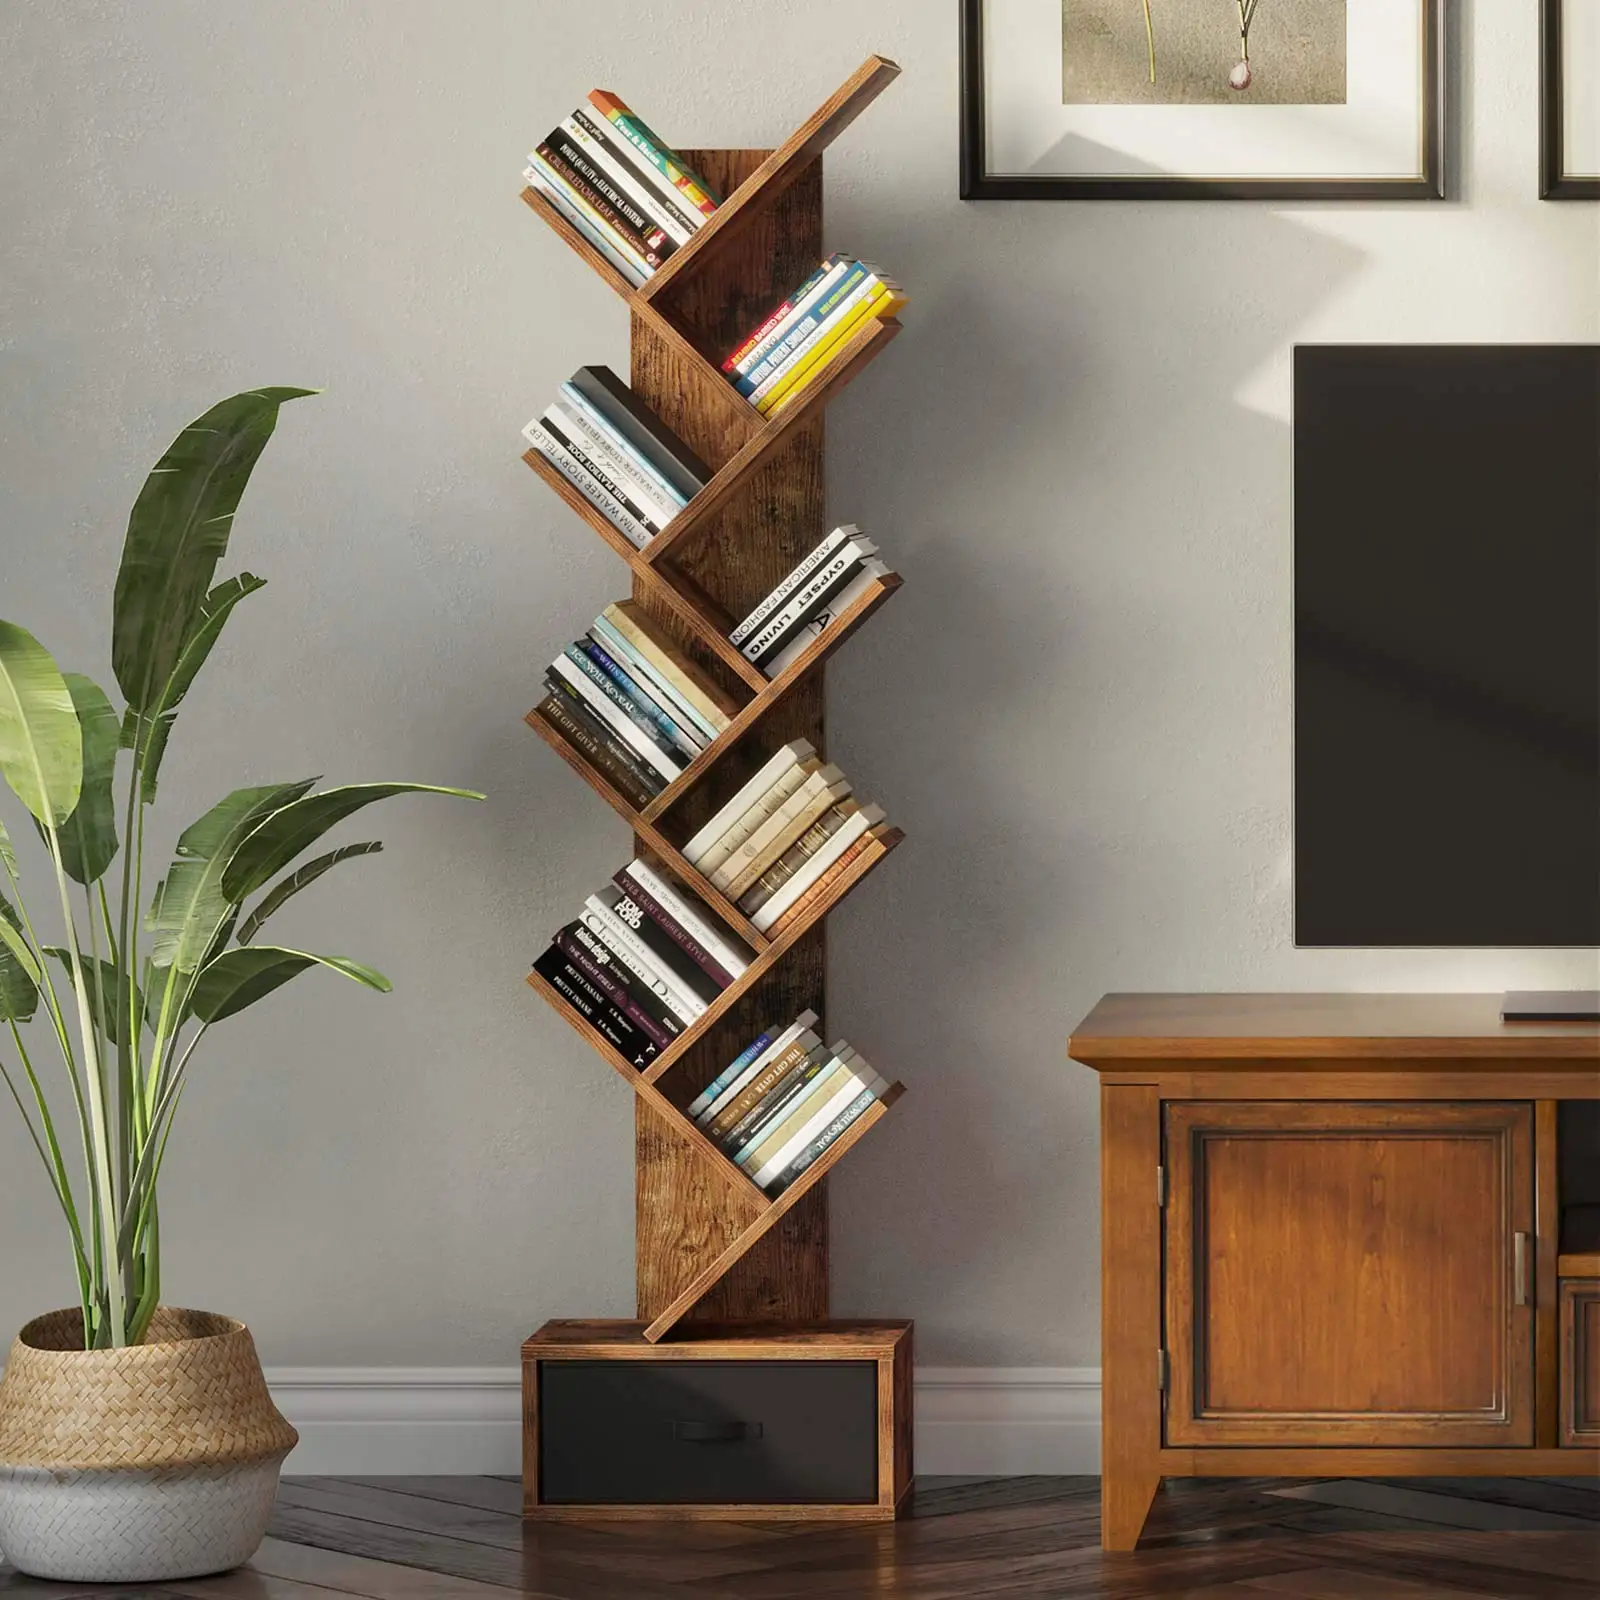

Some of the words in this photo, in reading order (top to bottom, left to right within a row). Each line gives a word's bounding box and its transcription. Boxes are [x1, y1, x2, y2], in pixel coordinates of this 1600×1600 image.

[613, 118, 634, 138] Pear
[630, 134, 641, 145] &
[558, 143, 578, 162] POWER
[572, 157, 596, 181] QUALITY
[595, 178, 626, 209] ELECTRICAL
[620, 203, 645, 228] SYSTEMS
[579, 185, 598, 204] OAK
[593, 199, 614, 219] LEAF
[730, 338, 757, 365] BEHIND
[753, 317, 778, 342] BARBED
[773, 303, 791, 321] WIRE
[742, 333, 779, 369] SARAJEVO
[527, 425, 560, 456] TELLER
[575, 415, 602, 441] TELLER
[565, 441, 587, 462] BOOK
[599, 438, 624, 463] STORY
[555, 452, 587, 484] STORY
[582, 459, 615, 490] PLAYBOY
[622, 461, 654, 492] WALKER
[583, 480, 622, 518] WALKER
[611, 487, 628, 503] THE
[617, 513, 637, 534] TIM
[775, 541, 833, 597] AMERICAN
[794, 558, 846, 608] GYPSET
[730, 595, 779, 642] FASHION
[747, 612, 792, 655] LIVING
[809, 608, 833, 632] A
[544, 701, 562, 719] THE
[558, 714, 579, 735] GIFT
[574, 730, 599, 754] GIVER
[613, 902, 641, 930] FORD
[619, 895, 644, 919] TOM
[619, 877, 639, 896] YVES
[636, 893, 657, 914] SAINT
[656, 913, 687, 943] LAURENT
[685, 941, 708, 963] STYLE
[573, 926, 596, 949] Fashion
[587, 942, 613, 967] design
[582, 912, 651, 978] Christian
[649, 978, 687, 1014] Dior
[563, 963, 585, 985] PRETTY
[581, 981, 604, 1004] INSANE
[567, 945, 581, 958] THE
[578, 955, 599, 976] NIGHT
[595, 972, 615, 992] ITSELF
[552, 975, 574, 997] PRETTY
[570, 993, 593, 1015] INSANE
[771, 1059, 789, 1076] GIFT
[784, 1047, 800, 1063] THE
[753, 1072, 775, 1094] GIVER
